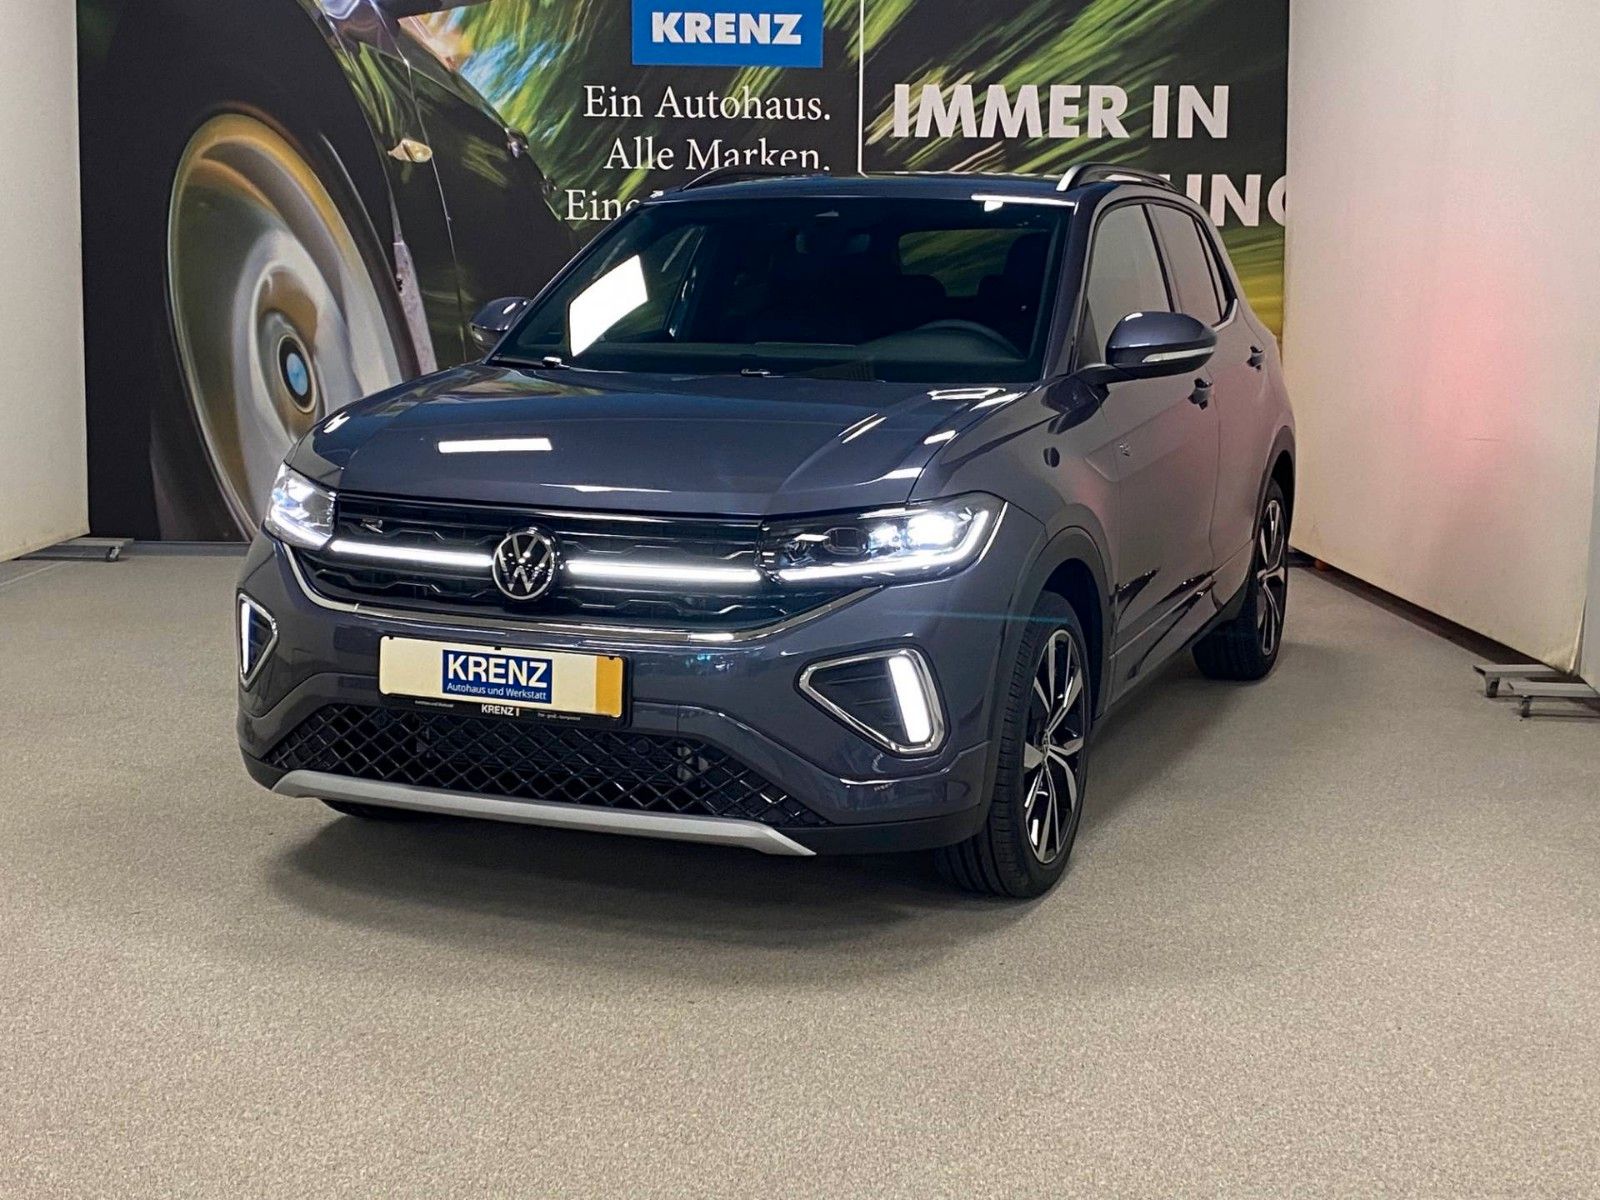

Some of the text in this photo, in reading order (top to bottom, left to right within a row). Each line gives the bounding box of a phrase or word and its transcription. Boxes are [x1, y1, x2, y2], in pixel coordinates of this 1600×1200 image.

[651, 12, 802, 45] KRENZ
[583, 85, 831, 121] Ein Autohaus.
[893, 84, 1230, 139] IMMER IN
[603, 136, 830, 171] Alle Marken.
[447, 653, 548, 689] KRENZ
[446, 682, 547, 700] Autohaus und Werkstatt
[481, 703, 514, 716] KRENZ
